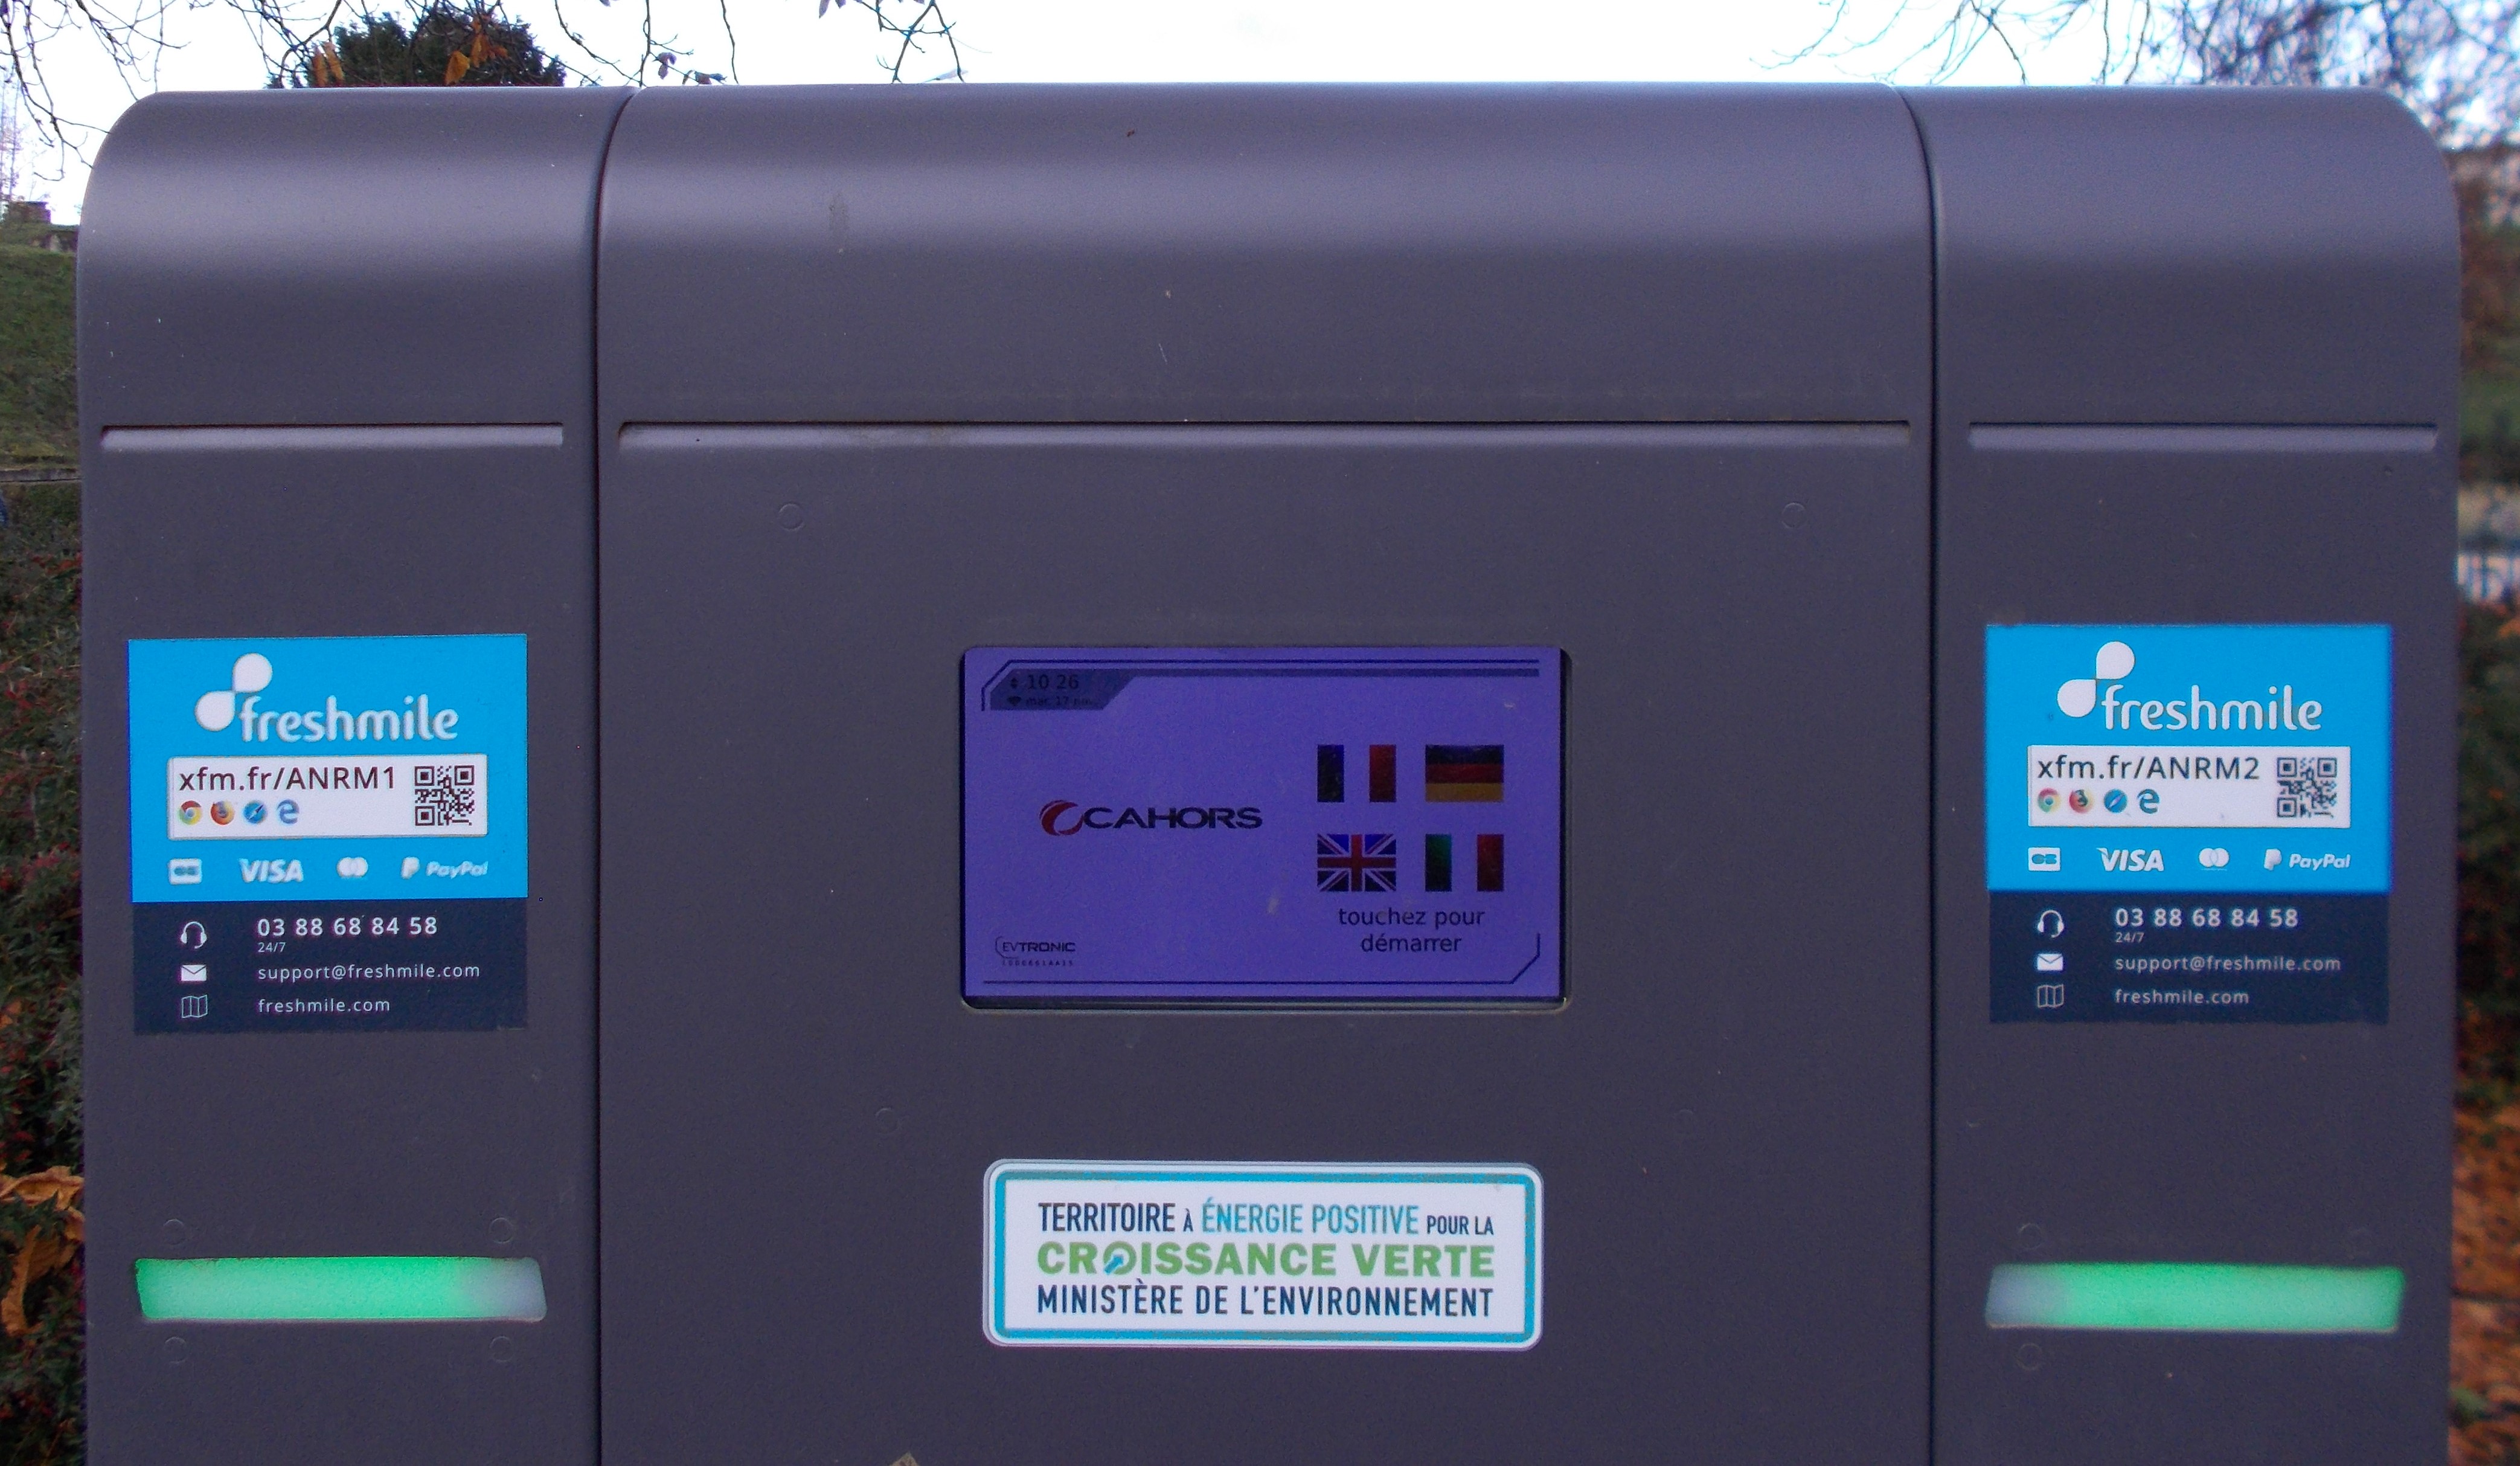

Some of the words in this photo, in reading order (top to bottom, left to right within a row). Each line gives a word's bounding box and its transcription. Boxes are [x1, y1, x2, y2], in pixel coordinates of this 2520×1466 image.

[1027, 674, 1050, 690] 10
[1056, 674, 1079, 690] 26
[2102, 684, 2322, 730] freshmile
[239, 693, 458, 742] freshmile
[2037, 756, 2260, 780] xfm.fr/ANRM2
[179, 766, 396, 791] xfm.fr/ANRM1
[1084, 807, 1262, 829] CAHORS
[2096, 847, 2165, 871] VISA
[2289, 854, 2350, 870] PayPal
[239, 858, 303, 883] VISA
[426, 860, 489, 878] PayPal
[257, 918, 285, 936] 03
[295, 918, 323, 936] 88
[333, 918, 361, 936] 68
[371, 918, 400, 935] 84
[410, 917, 438, 935] 58
[1338, 907, 1426, 926] touchez
[1435, 911, 1485, 928] pour
[2115, 908, 2144, 927] 03
[2154, 908, 2182, 927] 88
[2192, 908, 2220, 927] 68
[2231, 908, 2259, 927] 84
[2269, 908, 2298, 927] 58
[257, 942, 285, 953] 24/7
[1002, 942, 1076, 952] EVTRONIC
[1361, 934, 1462, 952] démarrer
[2115, 931, 2144, 944] 24/7
[258, 964, 479, 983] support@freshmile.com
[2115, 955, 2341, 974] support@freshmile.com
[258, 998, 390, 1014] freshmile.com
[2115, 989, 2249, 1005] freshmile.com
[1039, 1202, 1175, 1233] TERRITOIRE
[1184, 1207, 1194, 1232] À
[1202, 1197, 1303, 1233] ÉNERGIE
[1312, 1204, 1419, 1235] POSITIVE
[1426, 1215, 1470, 1235] POUR
[1475, 1215, 1494, 1236] LA
[1037, 1241, 1336, 1276] CROISSANCE
[1351, 1244, 1495, 1277] VERTE
[1038, 1278, 1182, 1314] MINISTÈRE
[1196, 1287, 1228, 1315] DE
[1242, 1287, 1493, 1317] L'ENVIRONNEMENT
